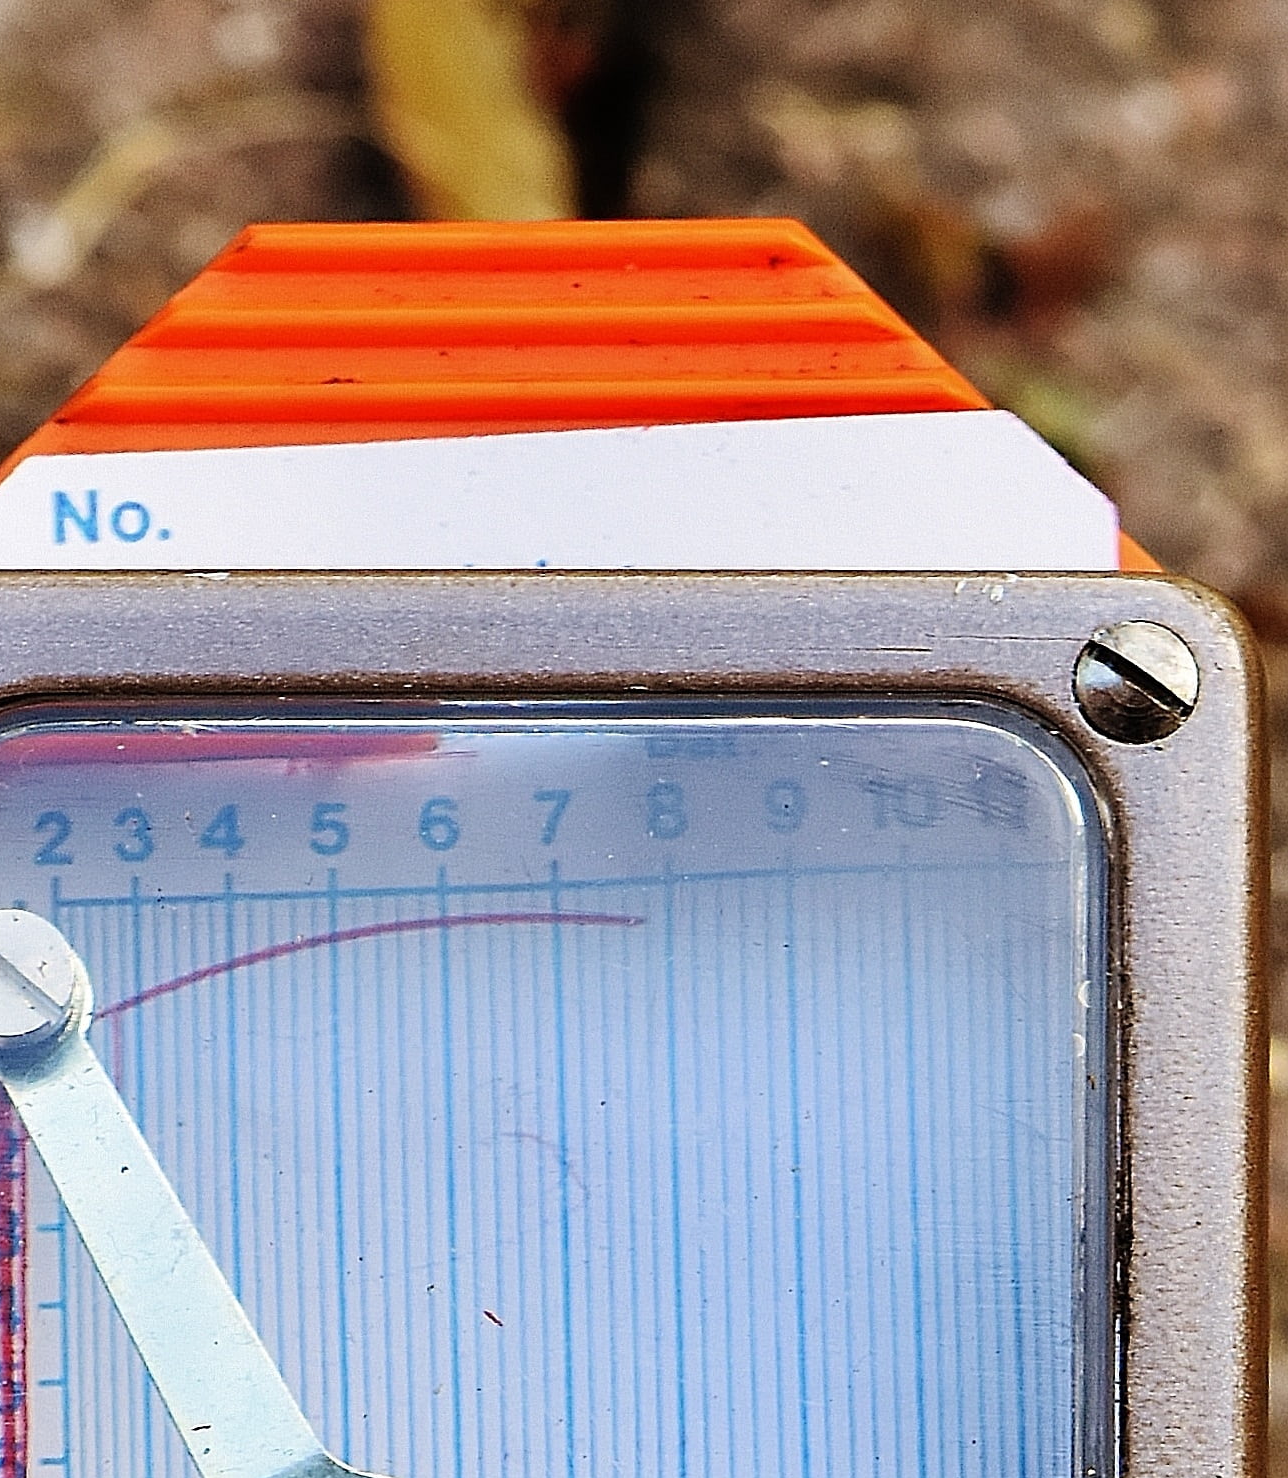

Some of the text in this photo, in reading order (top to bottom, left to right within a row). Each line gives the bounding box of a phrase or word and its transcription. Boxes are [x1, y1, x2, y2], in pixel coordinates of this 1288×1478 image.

[52, 488, 171, 545] No.
[33, 811, 74, 865] 2
[112, 808, 155, 863] 3
[199, 804, 244, 858] 4
[310, 802, 350, 856] 5
[418, 796, 461, 851] 6
[533, 788, 572, 844] 7
[646, 780, 689, 840] 8
[763, 777, 808, 834] 9
